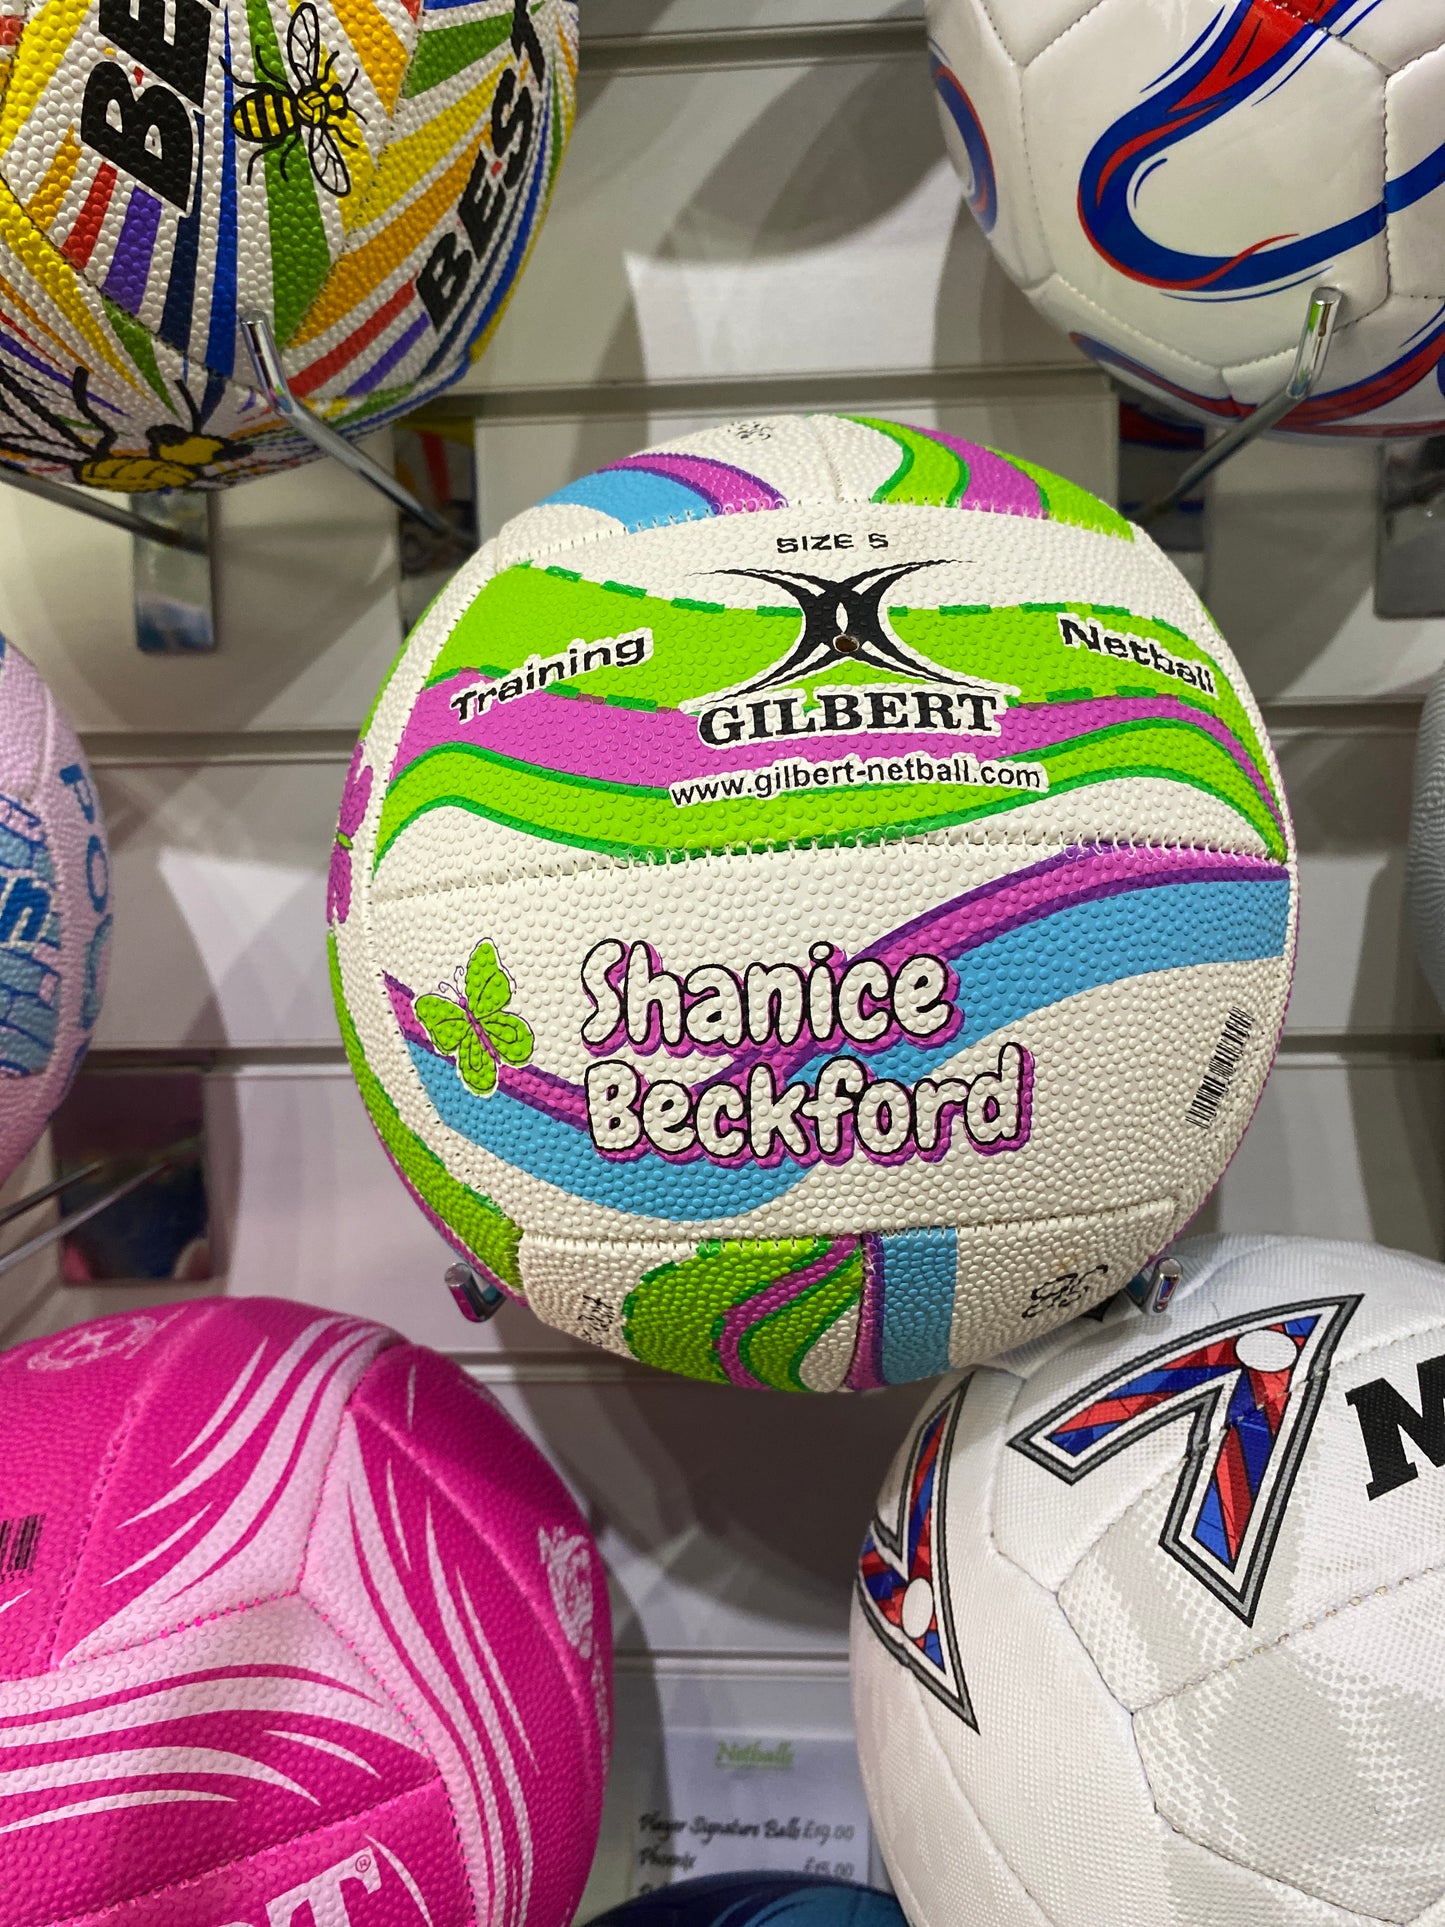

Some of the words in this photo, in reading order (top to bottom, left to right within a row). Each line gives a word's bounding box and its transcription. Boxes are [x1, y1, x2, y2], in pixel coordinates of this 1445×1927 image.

[81, 0, 219, 212] BE
[416, 0, 546, 334] BEST
[776, 533, 855, 554] SIZE
[868, 533, 890, 549] 5
[451, 636, 645, 722] Training
[1060, 618, 1214, 694] Netball
[699, 691, 997, 746] GILBERT
[671, 757, 1041, 806] www.gilbert-netball.com
[581, 938, 961, 1052] Shanice
[584, 1042, 1034, 1164] Beckford
[689, 1815, 761, 1845] Signature
